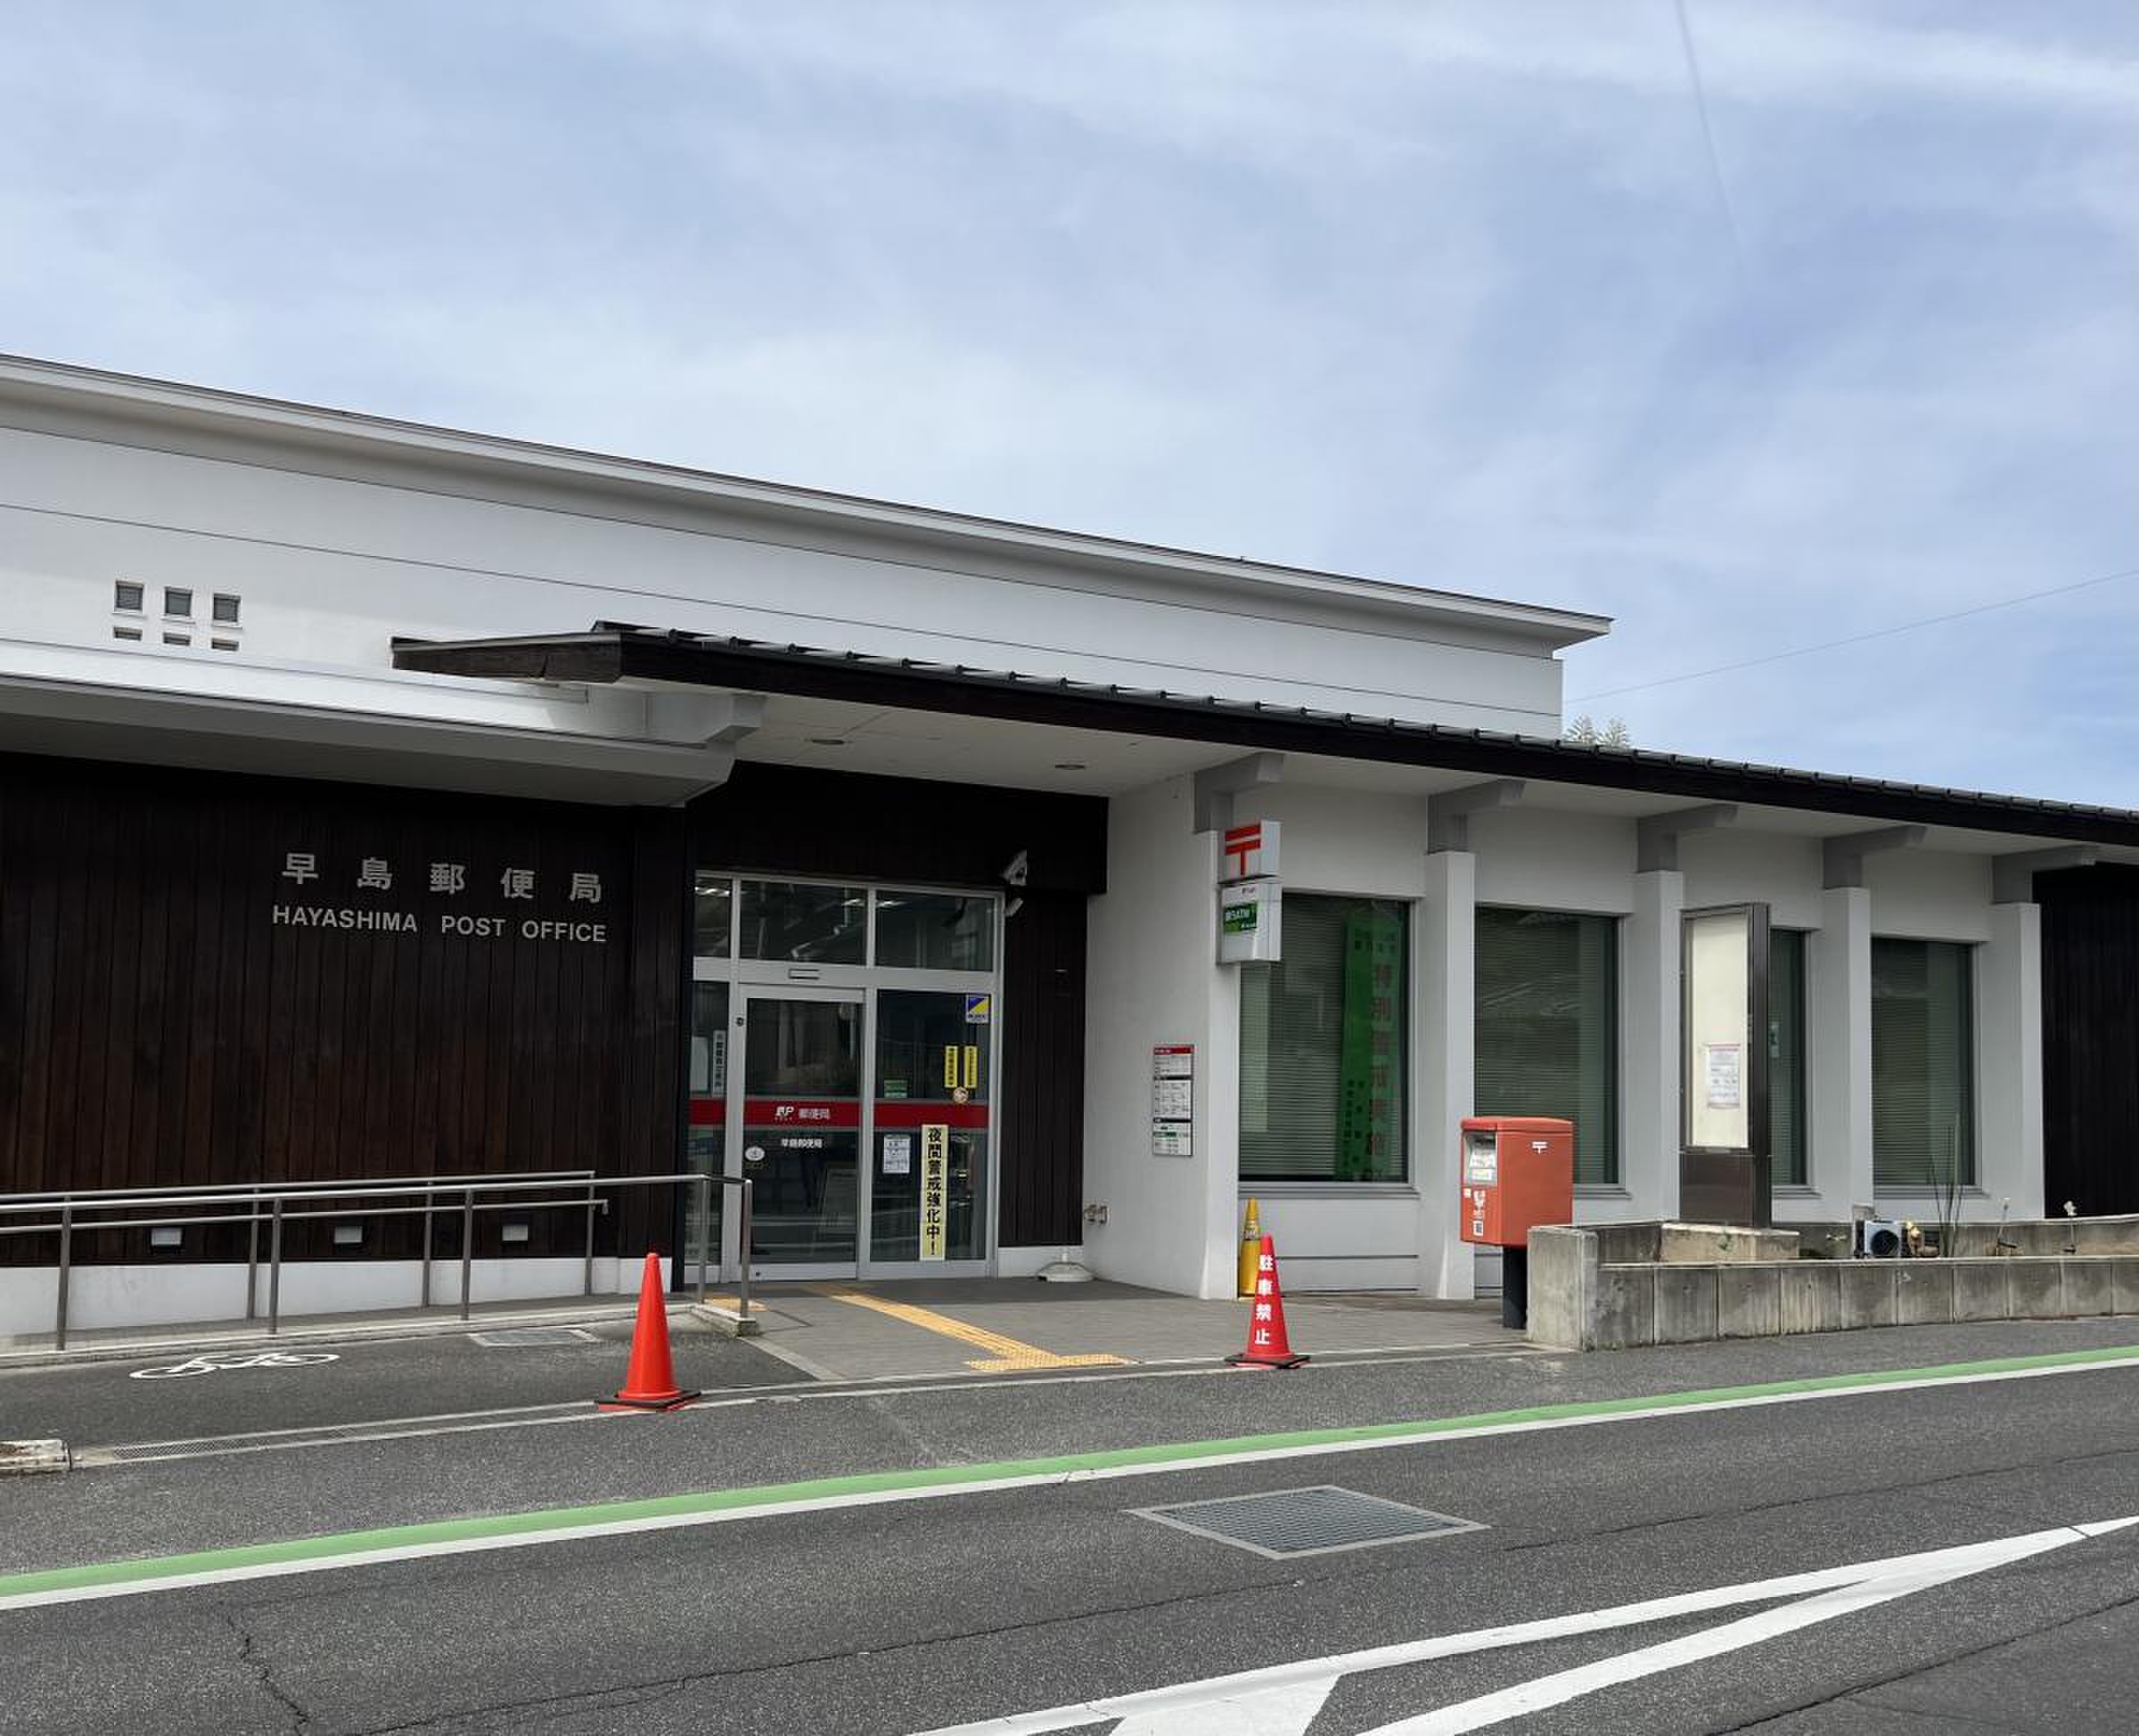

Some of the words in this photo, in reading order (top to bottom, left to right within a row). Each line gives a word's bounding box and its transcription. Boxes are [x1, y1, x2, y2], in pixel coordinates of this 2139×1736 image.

[282, 853, 602, 904] 早島郵便局
[273, 905, 418, 932] HAYASHIMA
[441, 915, 506, 937] POST
[521, 921, 608, 942] OFFICE
[1254, 1255, 1274, 1346] 駐車禁止
